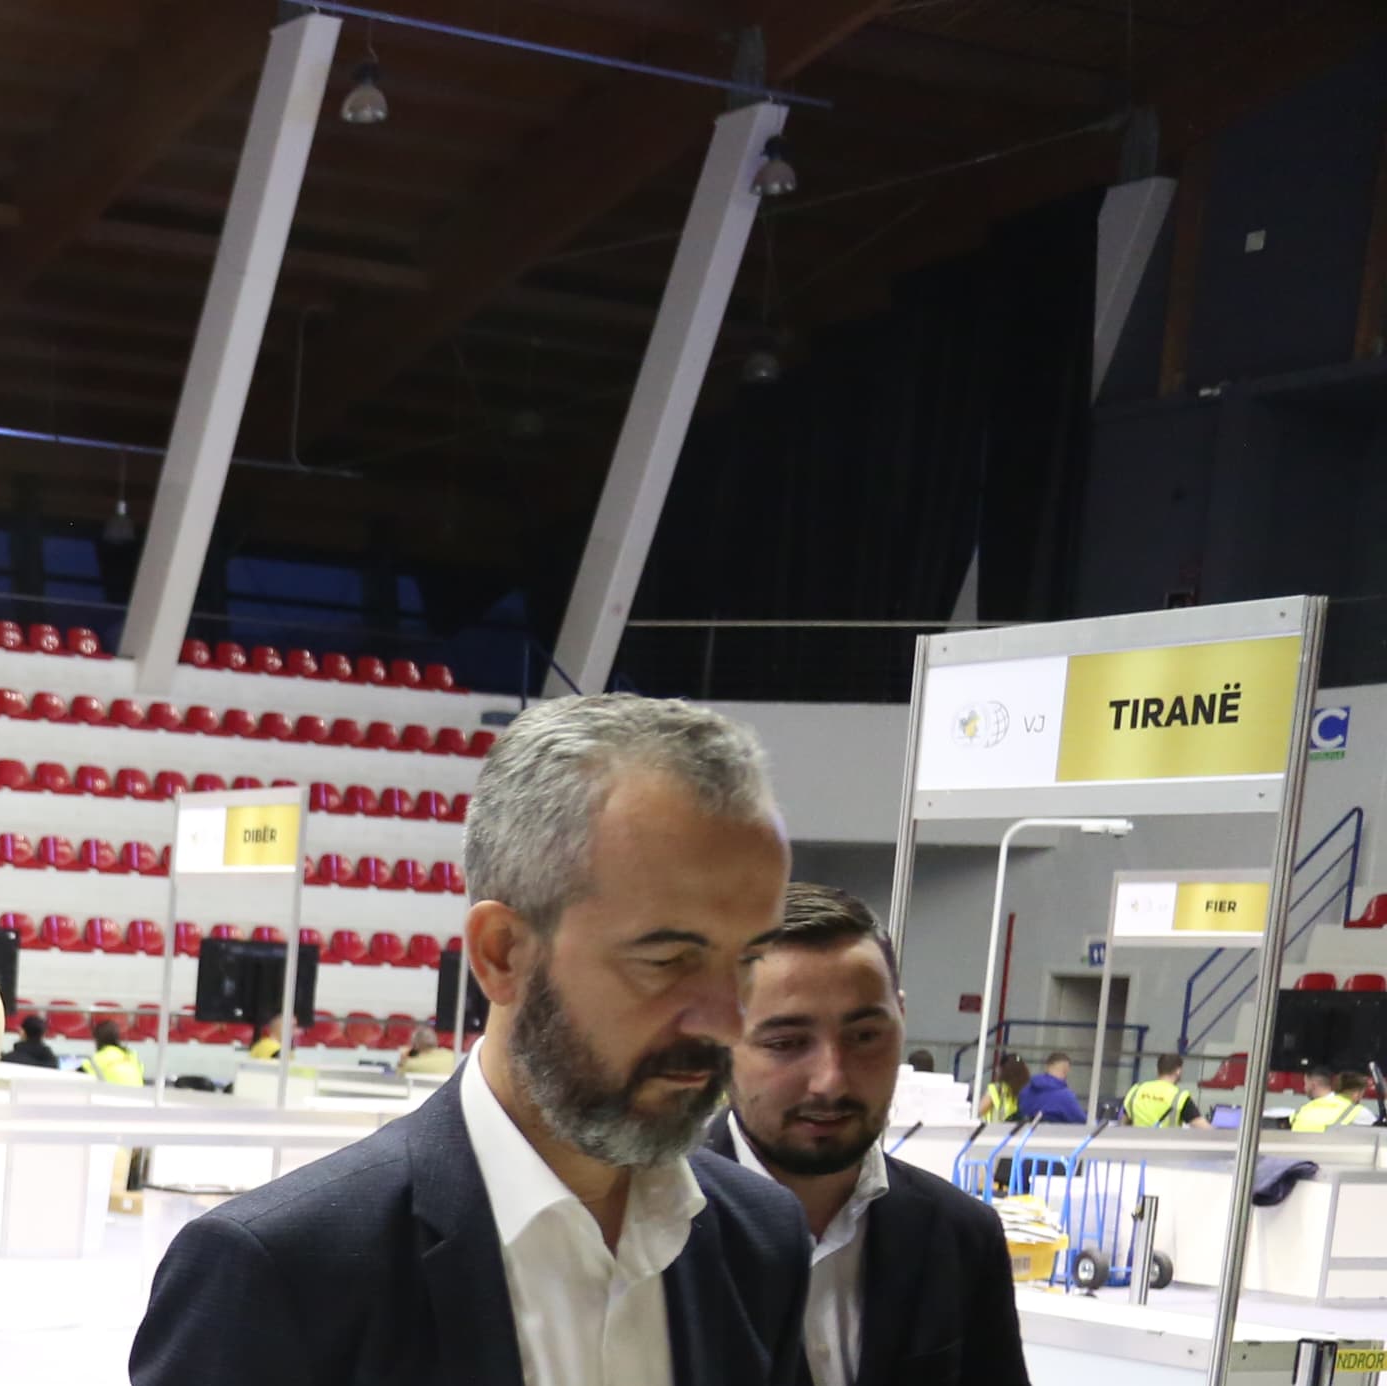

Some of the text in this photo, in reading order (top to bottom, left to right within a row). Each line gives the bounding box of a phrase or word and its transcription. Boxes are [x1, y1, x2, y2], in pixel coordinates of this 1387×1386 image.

[1109, 682, 1242, 730] TIRANË
[1311, 708, 1348, 750] C
[1205, 900, 1237, 912] FIER
[1337, 1352, 1385, 1369] NDROR
